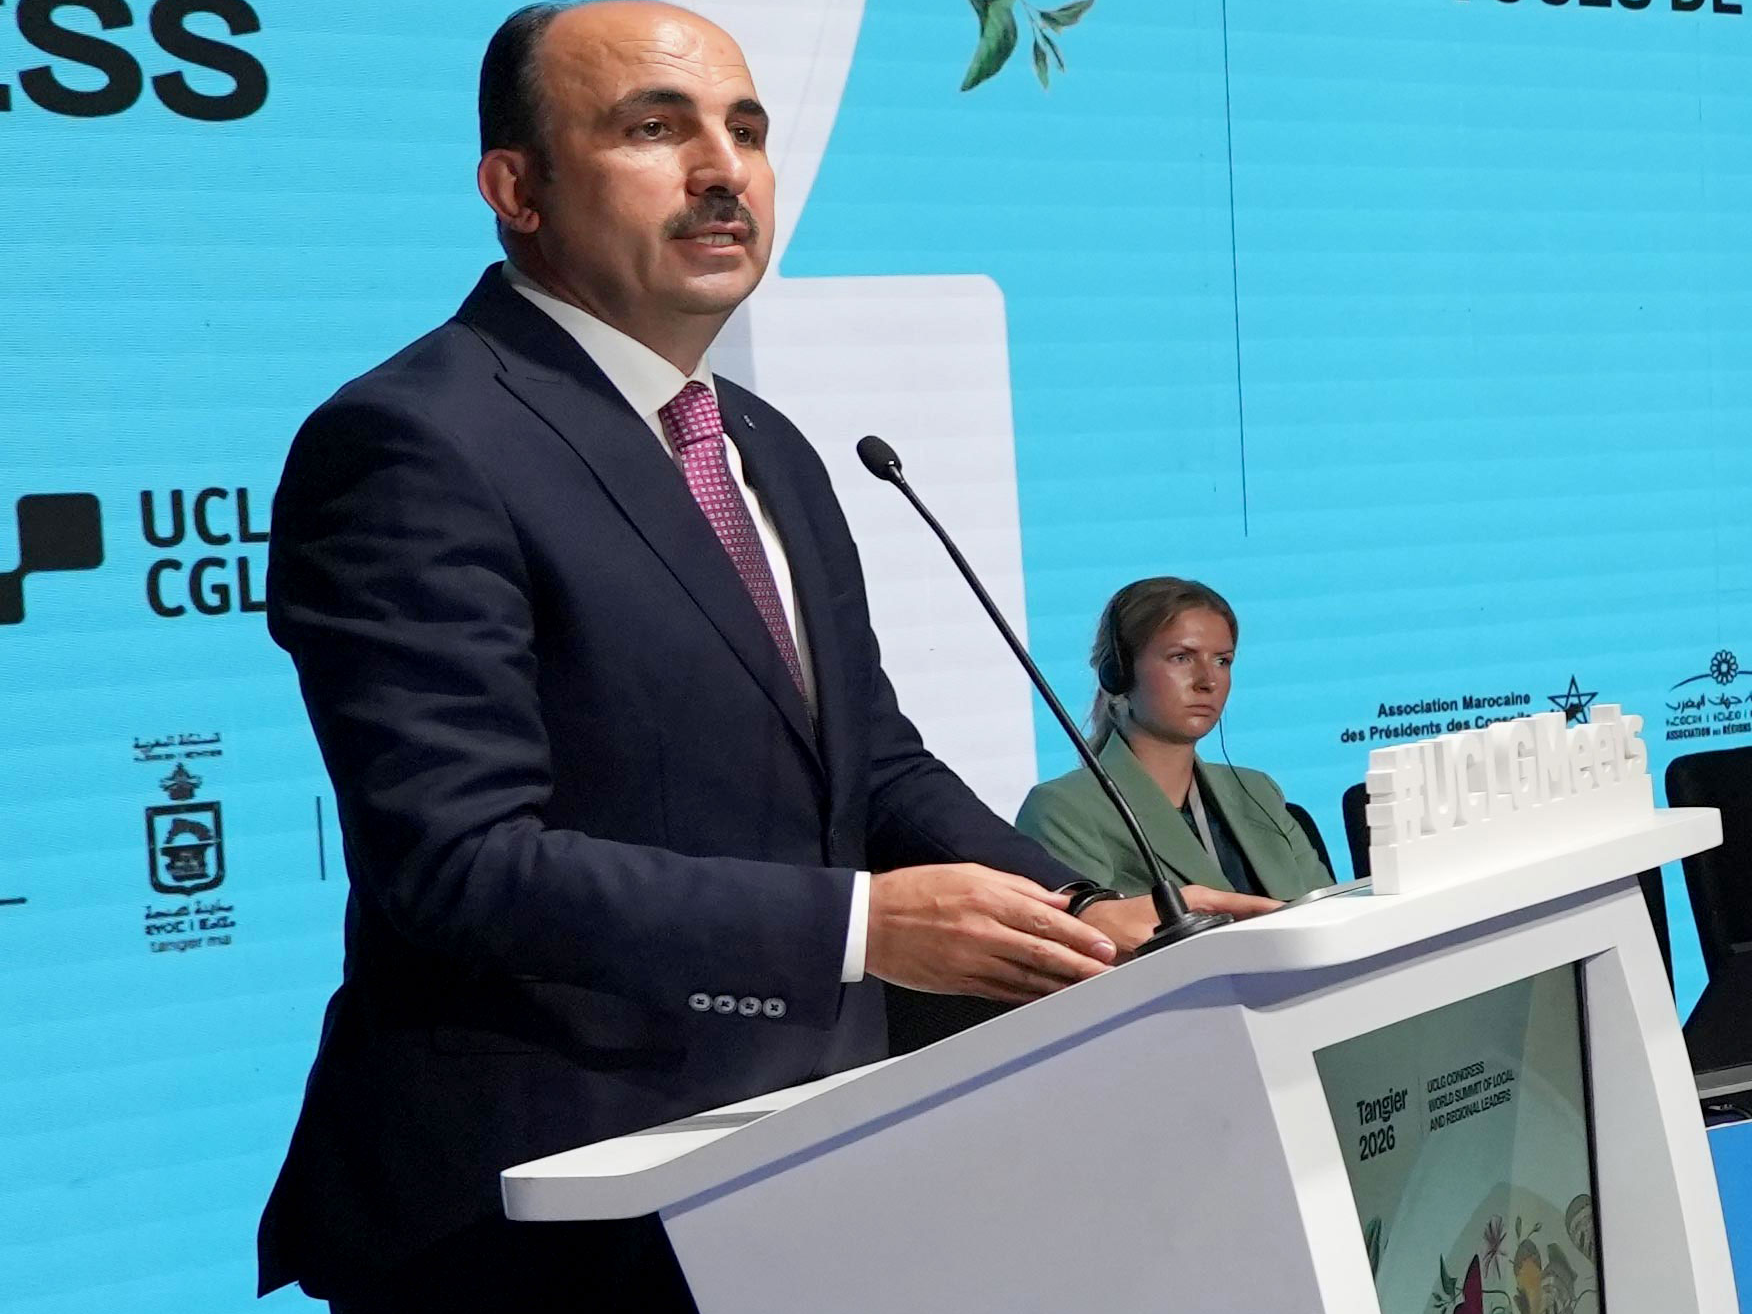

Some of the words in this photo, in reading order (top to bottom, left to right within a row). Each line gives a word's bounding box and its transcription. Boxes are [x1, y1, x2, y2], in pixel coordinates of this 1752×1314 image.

[1378, 696, 1458, 718] Association
[1462, 691, 1531, 710] Marocaine
[1340, 727, 1365, 744] des
[1370, 719, 1442, 741] Présidents
[1446, 716, 1471, 731] des
[1367, 703, 1649, 845] #UCLGMeets
[1357, 1088, 1408, 1126] Tangier
[1428, 1091, 1454, 1113] WORLD
[1430, 1115, 1446, 1132] AND
[1360, 1125, 1396, 1161] 2026
